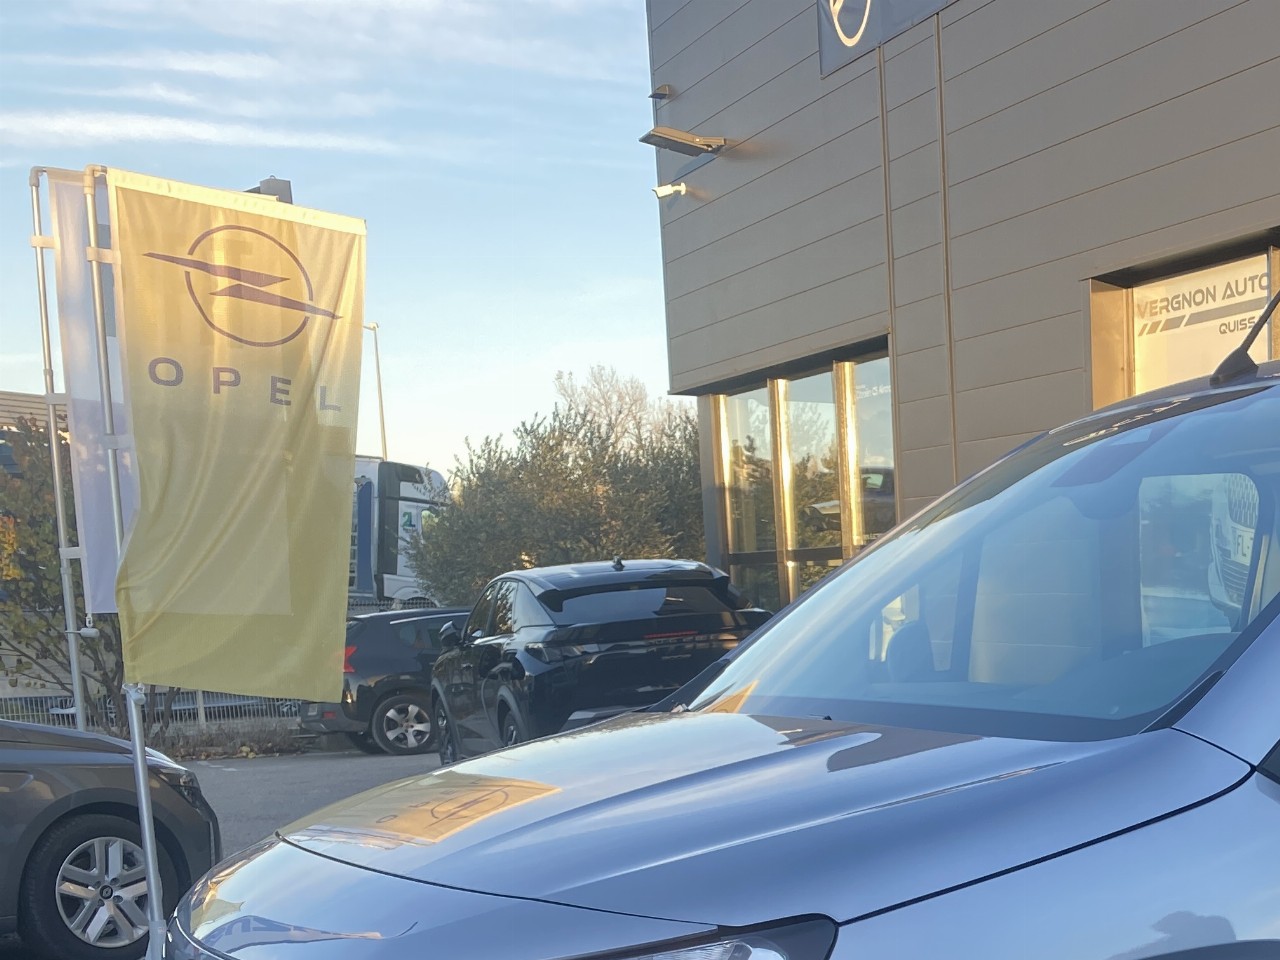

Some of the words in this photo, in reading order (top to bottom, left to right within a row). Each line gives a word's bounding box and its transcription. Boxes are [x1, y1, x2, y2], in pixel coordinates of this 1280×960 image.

[1137, 284, 1217, 319] VERGNON
[1221, 272, 1269, 301] AUTO
[148, 356, 341, 412] OPEL
